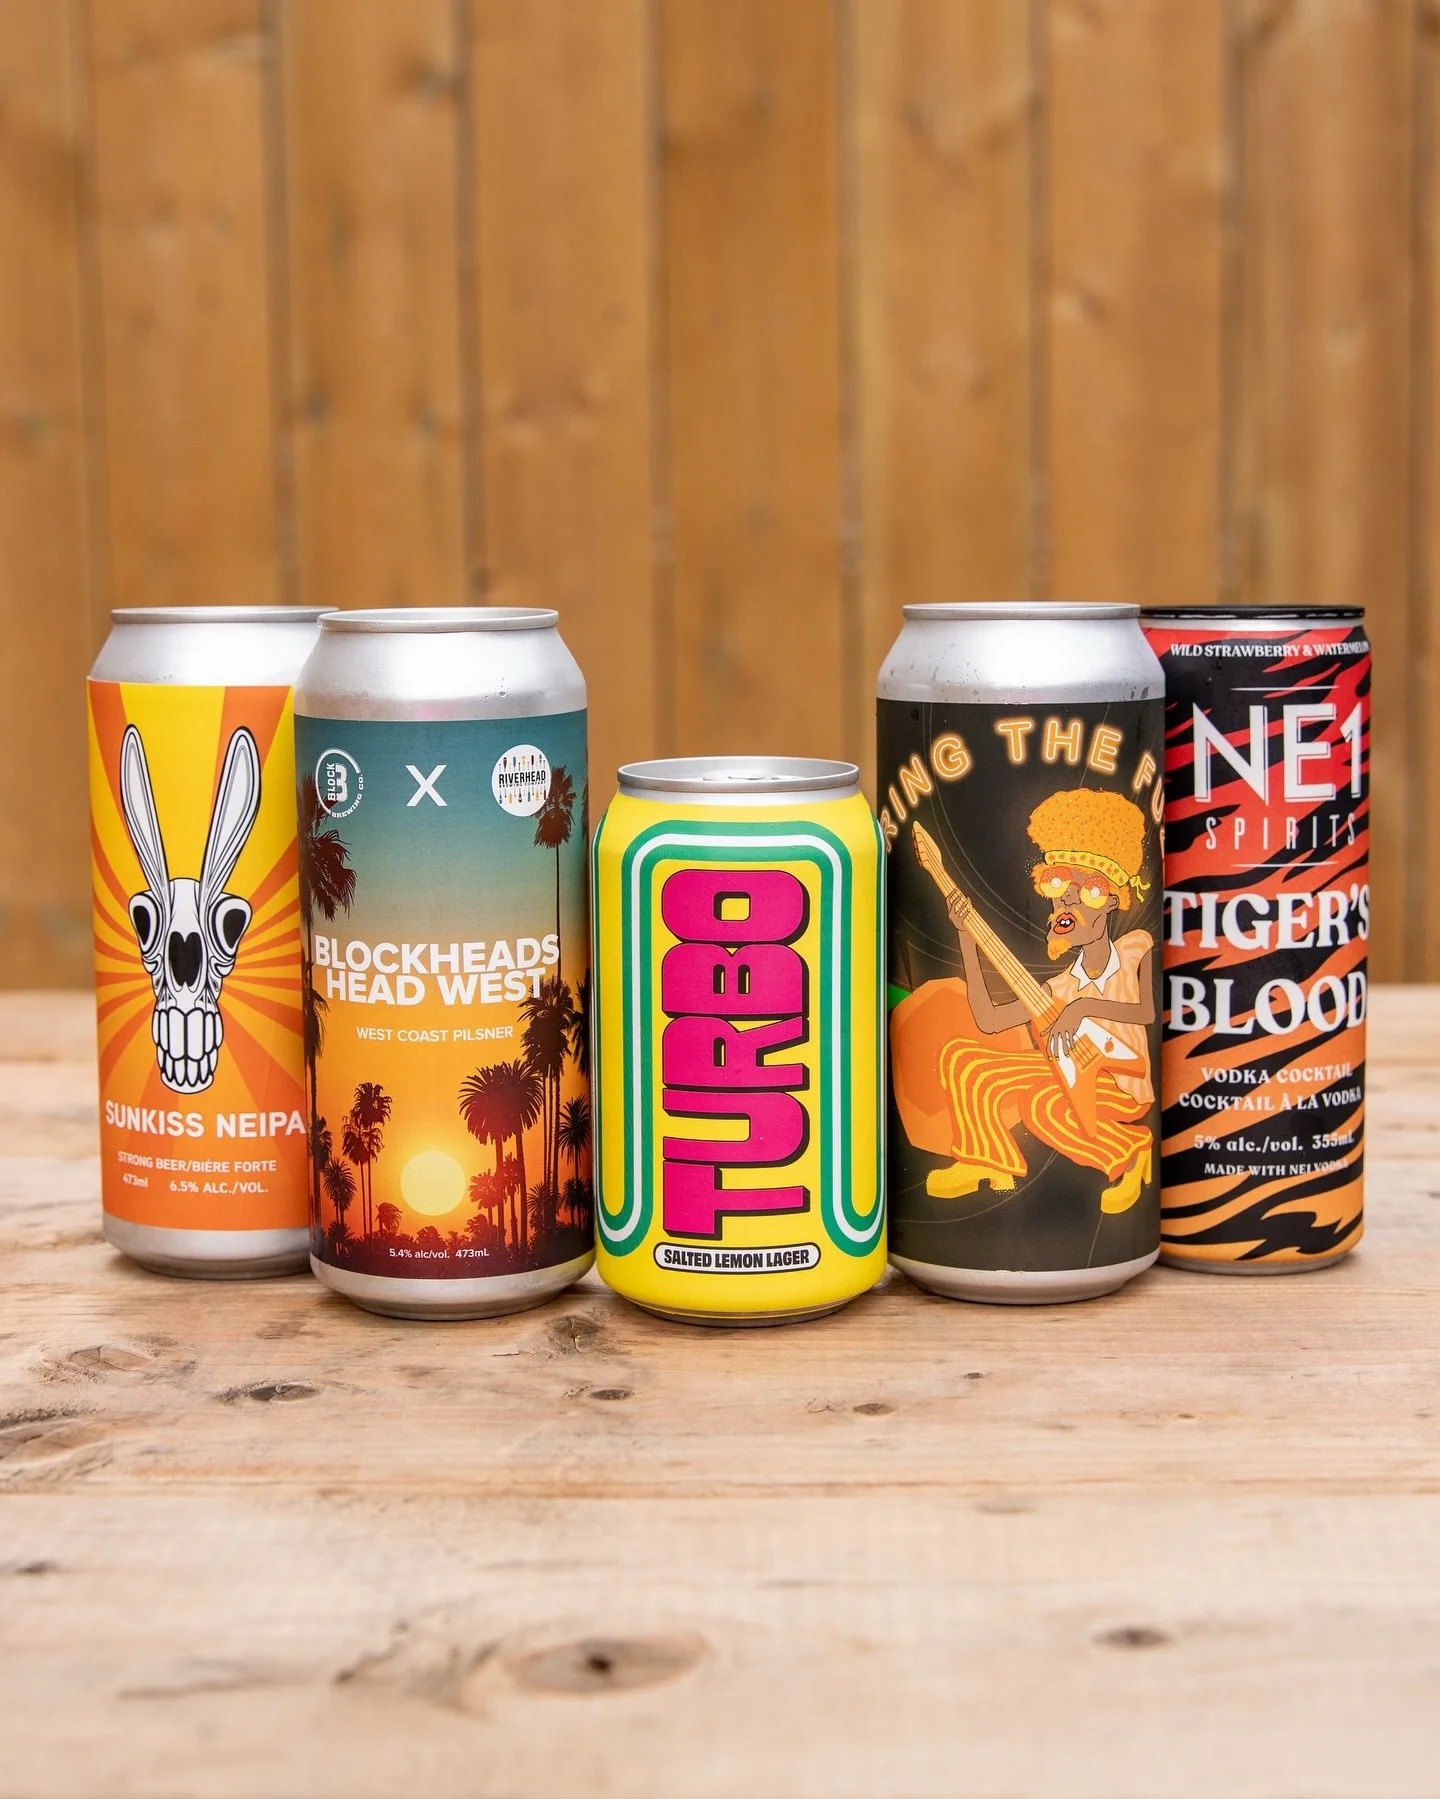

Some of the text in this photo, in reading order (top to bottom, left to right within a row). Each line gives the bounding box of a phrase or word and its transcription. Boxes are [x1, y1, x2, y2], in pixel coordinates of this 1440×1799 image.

[1171, 644, 1203, 657] WILD
[1205, 644, 1299, 658] STRAWBERRY
[1302, 644, 1312, 657] &
[1192, 702, 1362, 806] NE1
[326, 763, 336, 801] BLOCK
[405, 764, 448, 807] X
[498, 770, 546, 785] RIVERHEAD
[998, 718, 1122, 773] THE
[1135, 752, 1165, 862] FU
[331, 793, 363, 818] BREWING
[1205, 813, 1355, 850] SPIRITS
[1163, 883, 1370, 951] TIGER'S
[315, 934, 559, 975] BLOCKHEADS
[326, 967, 546, 1006] HEAD WEST
[1168, 971, 1367, 1035] BLOOD
[356, 1026, 514, 1042] WEST COAST PILSNER
[662, 869, 810, 1240] TURBO
[1202, 1063, 1353, 1084] VODKA COCKTAIL
[1178, 1086, 1362, 1111] COCKTAIL À LA VODKA
[105, 1100, 306, 1138] SUNKISS NEIPA
[1194, 1130, 1355, 1153] 5% alc./vol. 355mL
[117, 1151, 277, 1173] STRONG BEER/BIÈRE FORTE
[1204, 1163, 1245, 1175] MADE
[1249, 1164, 1286, 1176] WITH
[1313, 1158, 1349, 1173] VODKA
[122, 1173, 269, 1195] 473ml 6.5% ALC./VOL.
[389, 1248, 490, 1259] 5.4% alc/vol. 473mL
[664, 1249, 810, 1268] SALTED LEMON LAGER
